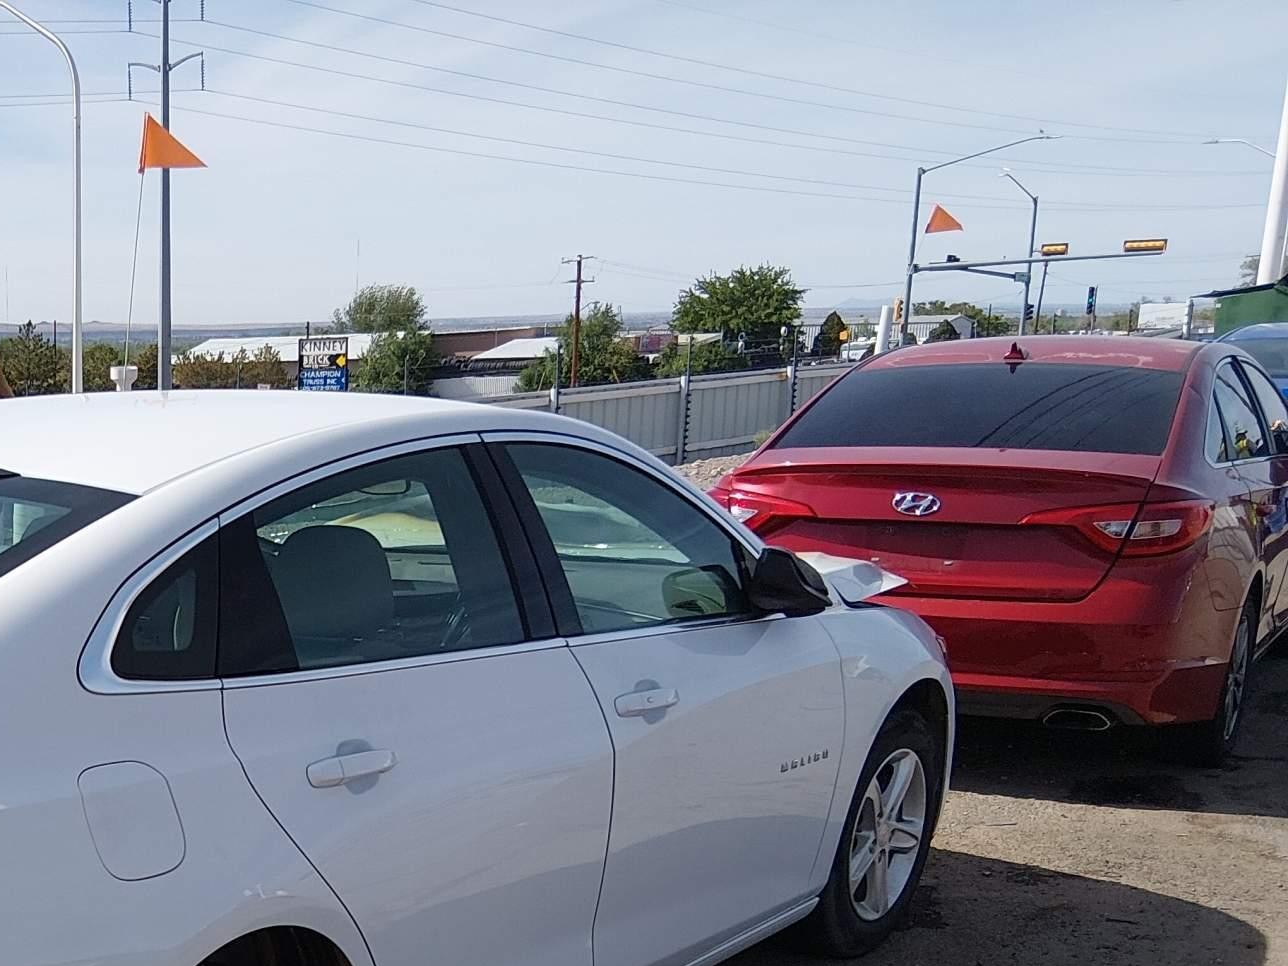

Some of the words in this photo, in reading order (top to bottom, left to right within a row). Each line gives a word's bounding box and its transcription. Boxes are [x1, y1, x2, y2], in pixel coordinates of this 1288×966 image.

[301, 340, 345, 352] KINNEY
[303, 354, 329, 366] BRICK
[780, 748, 829, 773] MALIBU
